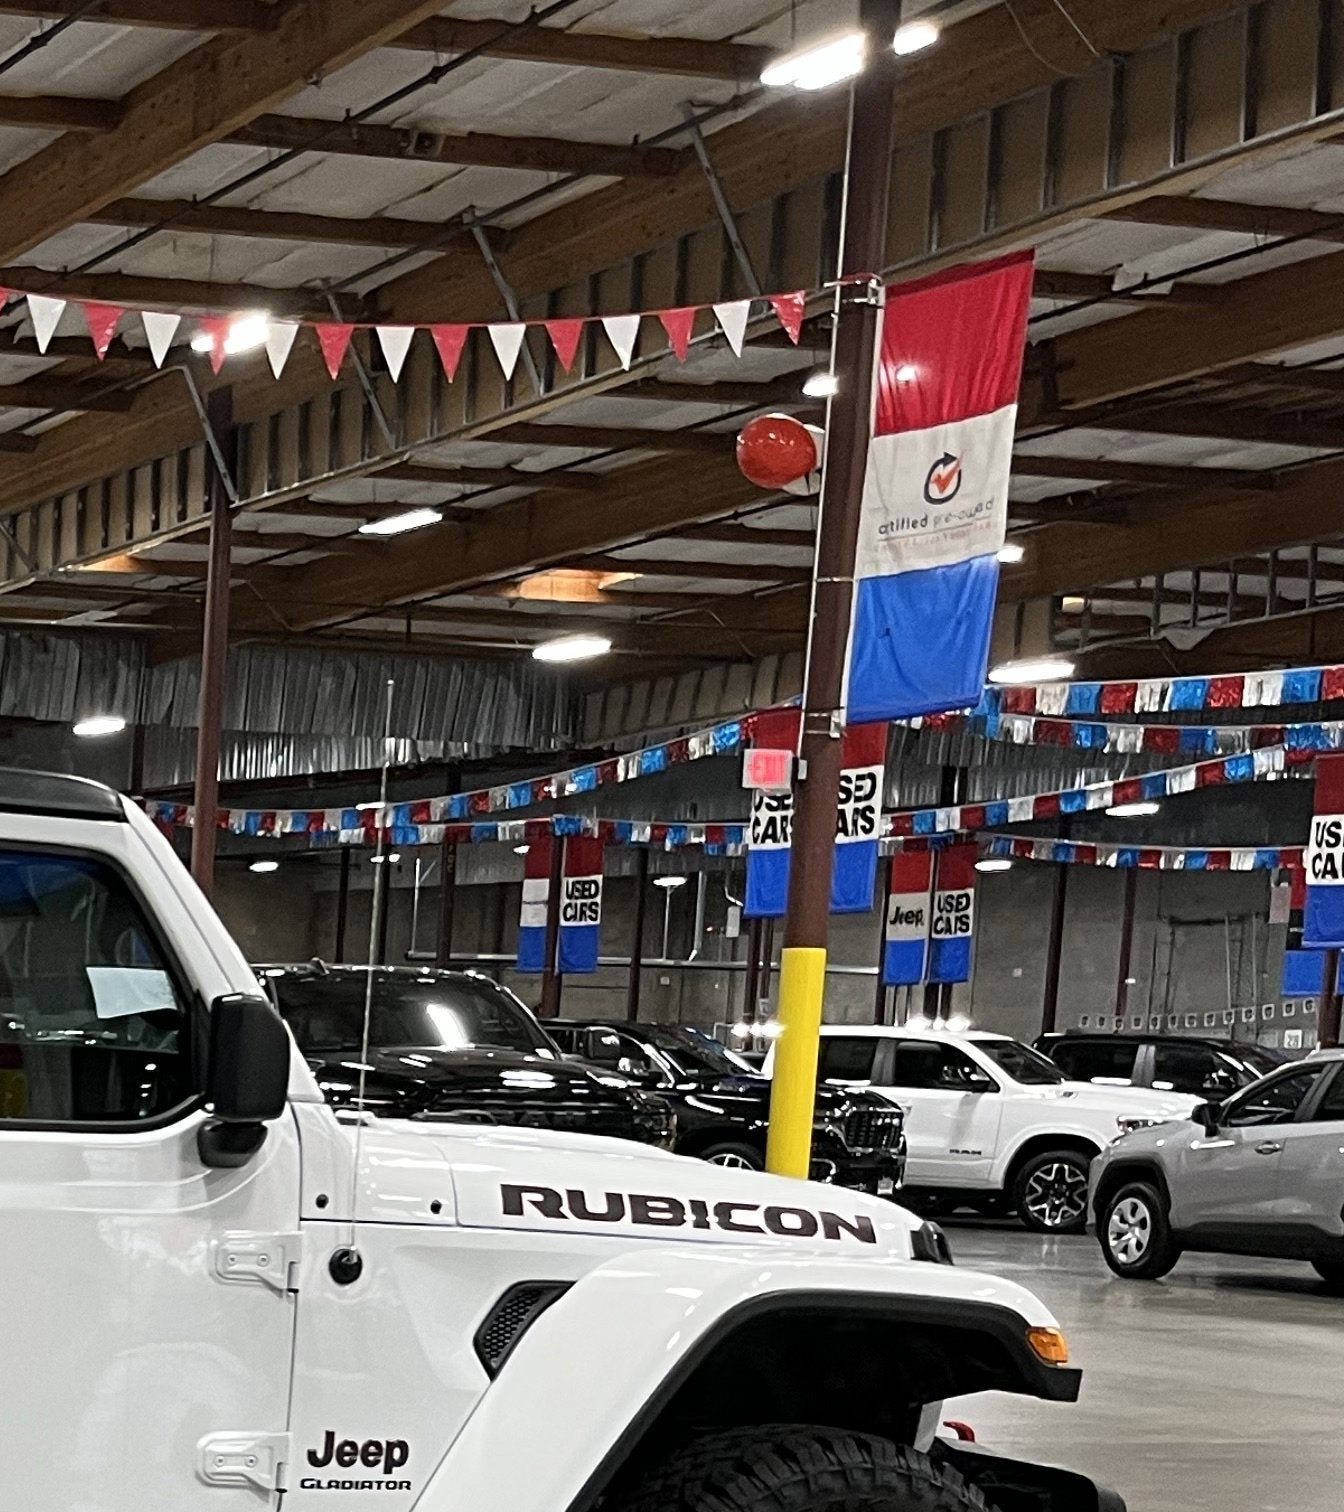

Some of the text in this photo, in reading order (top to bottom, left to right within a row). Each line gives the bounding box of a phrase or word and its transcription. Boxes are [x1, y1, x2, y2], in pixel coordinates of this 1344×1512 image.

[837, 772, 877, 804] SED
[752, 815, 792, 844] CAR
[836, 805, 875, 837] ARS
[566, 880, 599, 900] USED
[937, 893, 970, 913] USED
[500, 1183, 877, 1244] RUBICON
[307, 1430, 409, 1474] Jeep
[300, 1478, 411, 1490] GLADIATOR
